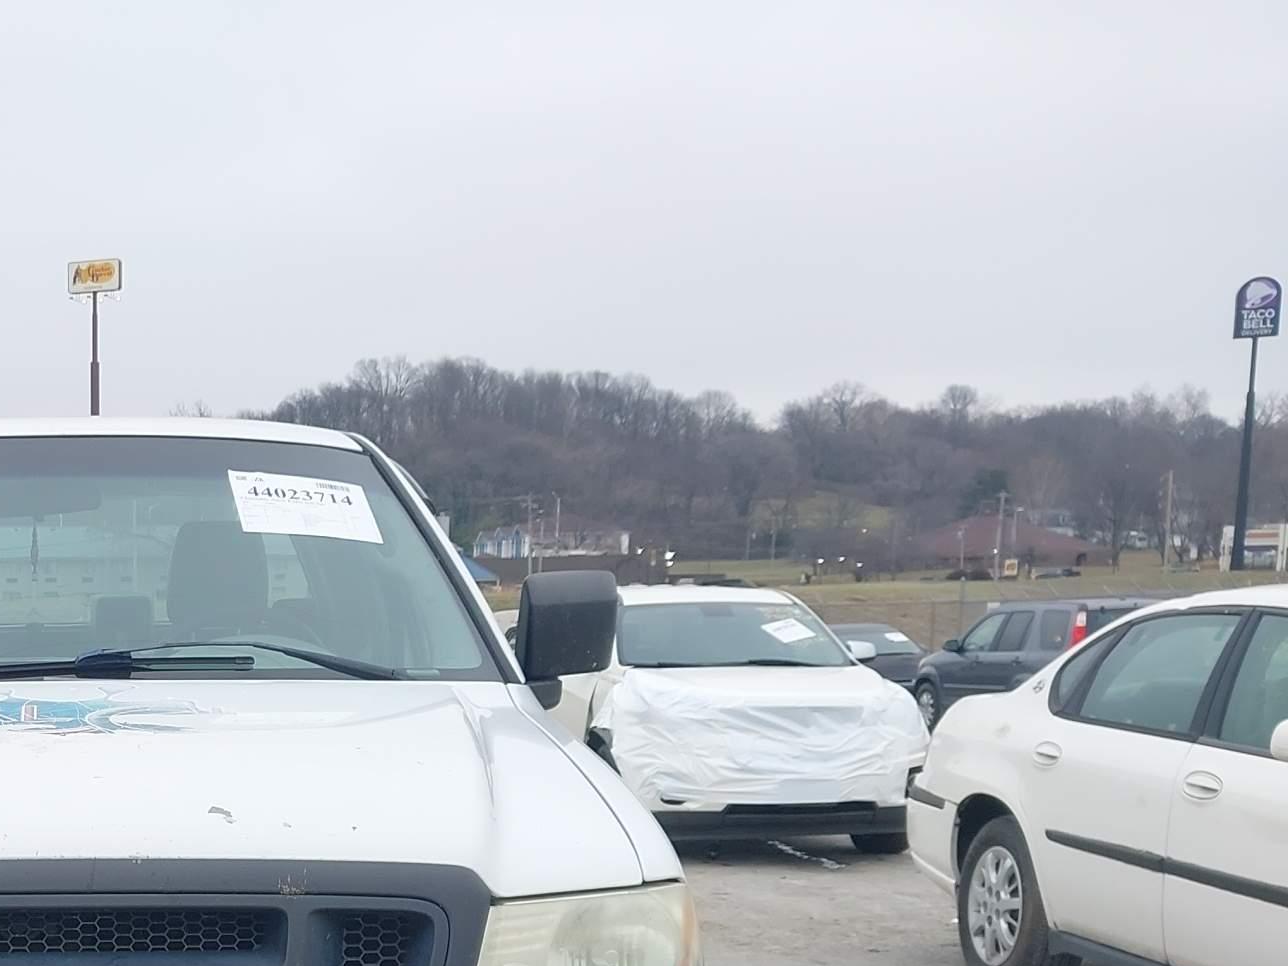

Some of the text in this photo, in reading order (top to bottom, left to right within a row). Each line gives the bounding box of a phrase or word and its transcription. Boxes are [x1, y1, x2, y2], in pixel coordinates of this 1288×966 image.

[1242, 309, 1275, 320] TACO
[1243, 319, 1274, 329] BELL
[247, 486, 353, 506] 44023714
